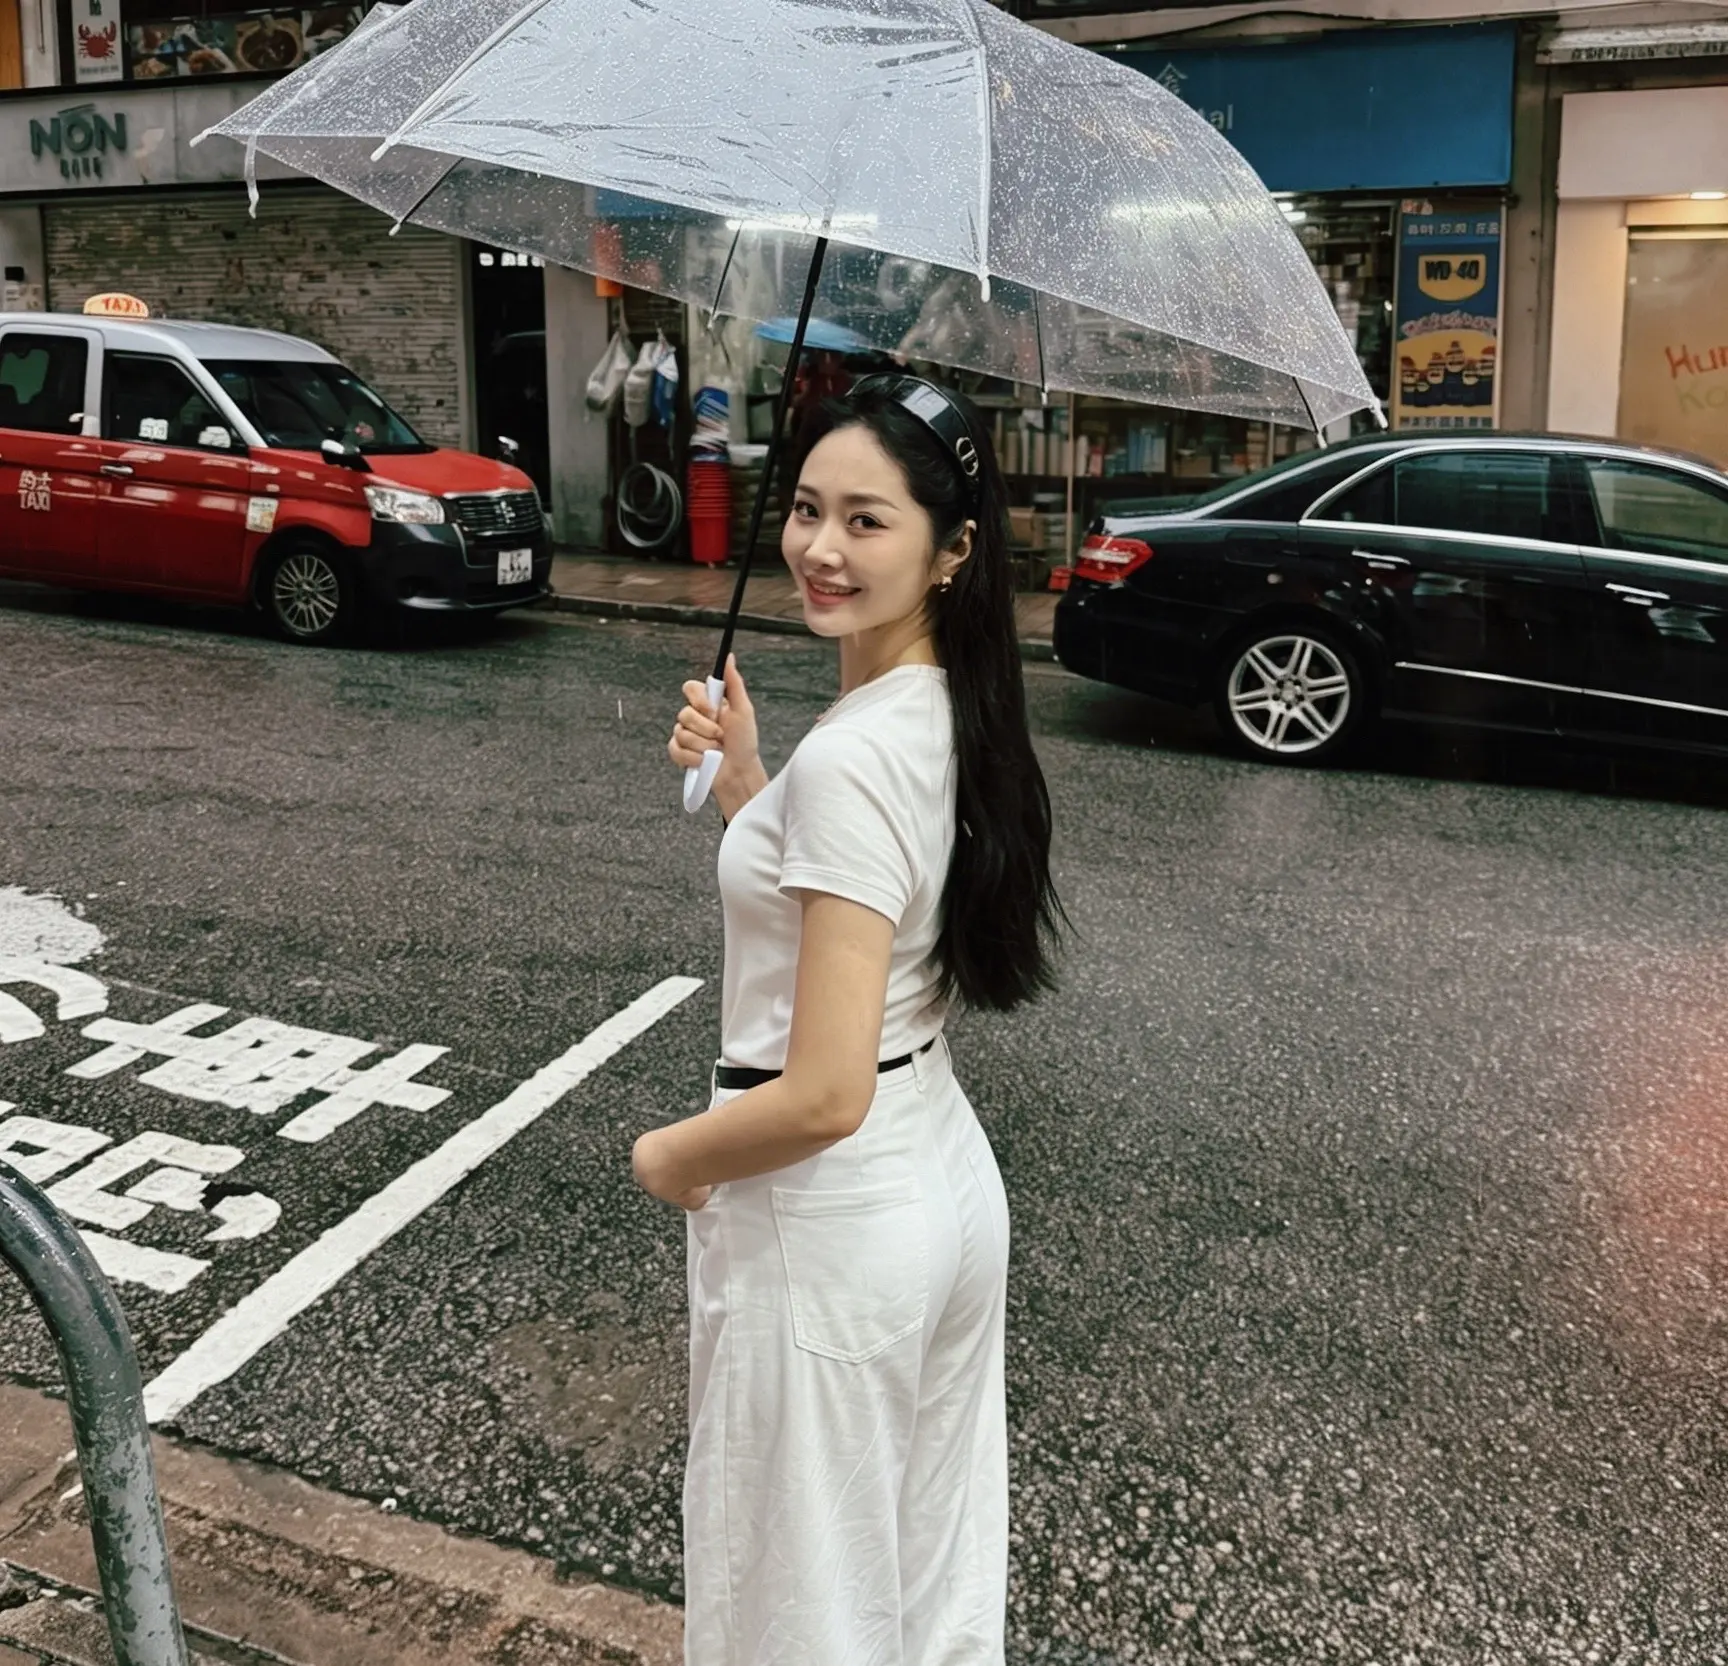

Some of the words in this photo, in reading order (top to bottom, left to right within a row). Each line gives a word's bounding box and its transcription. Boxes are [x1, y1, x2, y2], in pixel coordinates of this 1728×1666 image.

[1424, 260, 1480, 281] WD-40
[101, 297, 142, 313] TAXI
[18, 470, 54, 491] 的士
[18, 489, 52, 512] TAXI
